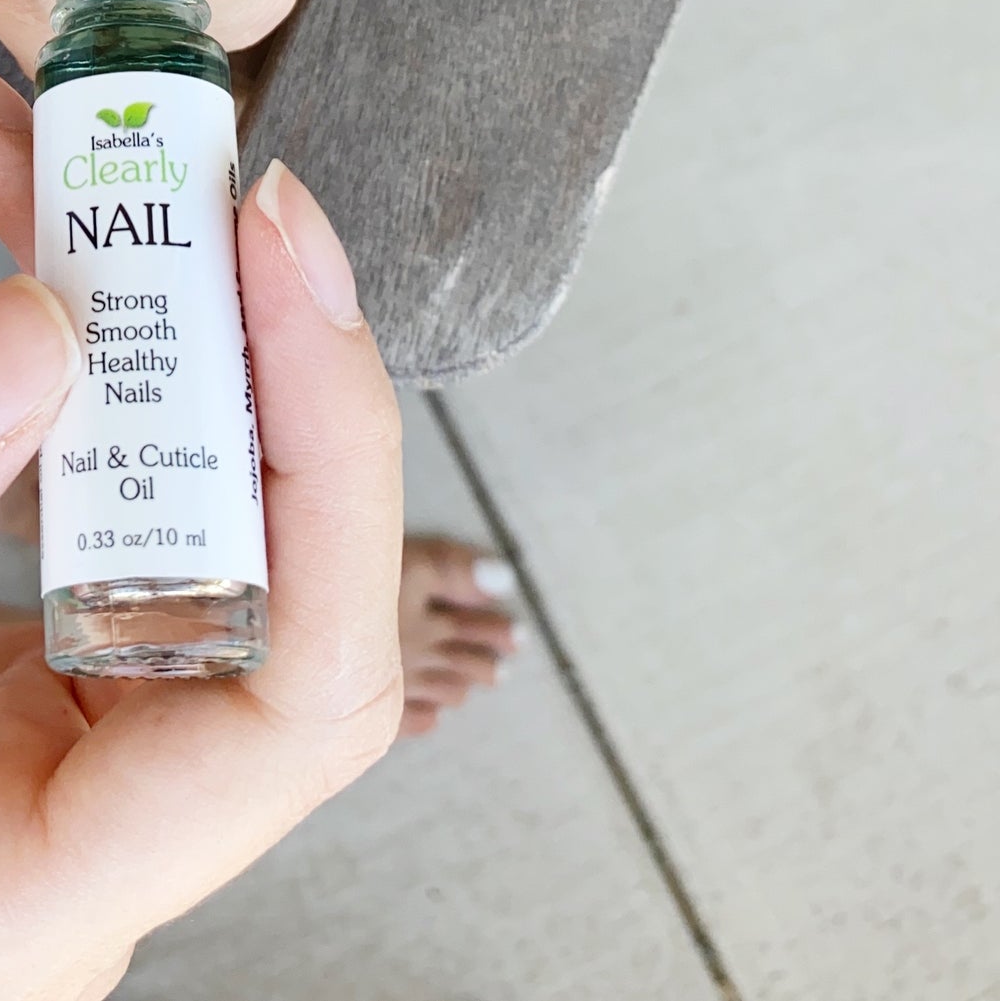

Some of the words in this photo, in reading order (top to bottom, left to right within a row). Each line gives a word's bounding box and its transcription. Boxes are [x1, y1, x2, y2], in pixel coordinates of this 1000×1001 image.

[91, 132, 164, 150] Isabella's
[63, 149, 188, 192] Clearly
[229, 162, 237, 200] Oils
[66, 203, 192, 255] NAIL
[91, 290, 168, 314] Strong
[86, 318, 177, 344] Smooth
[88, 349, 178, 377] Healthy
[105, 379, 163, 405] Nails
[61, 448, 98, 476] Nail
[107, 445, 129, 469] &
[139, 443, 219, 470] Cuticle
[120, 476, 154, 500] Oil
[77, 530, 115, 551] 0.33
[122, 528, 178, 548] oz/10
[186, 529, 206, 547] ml
